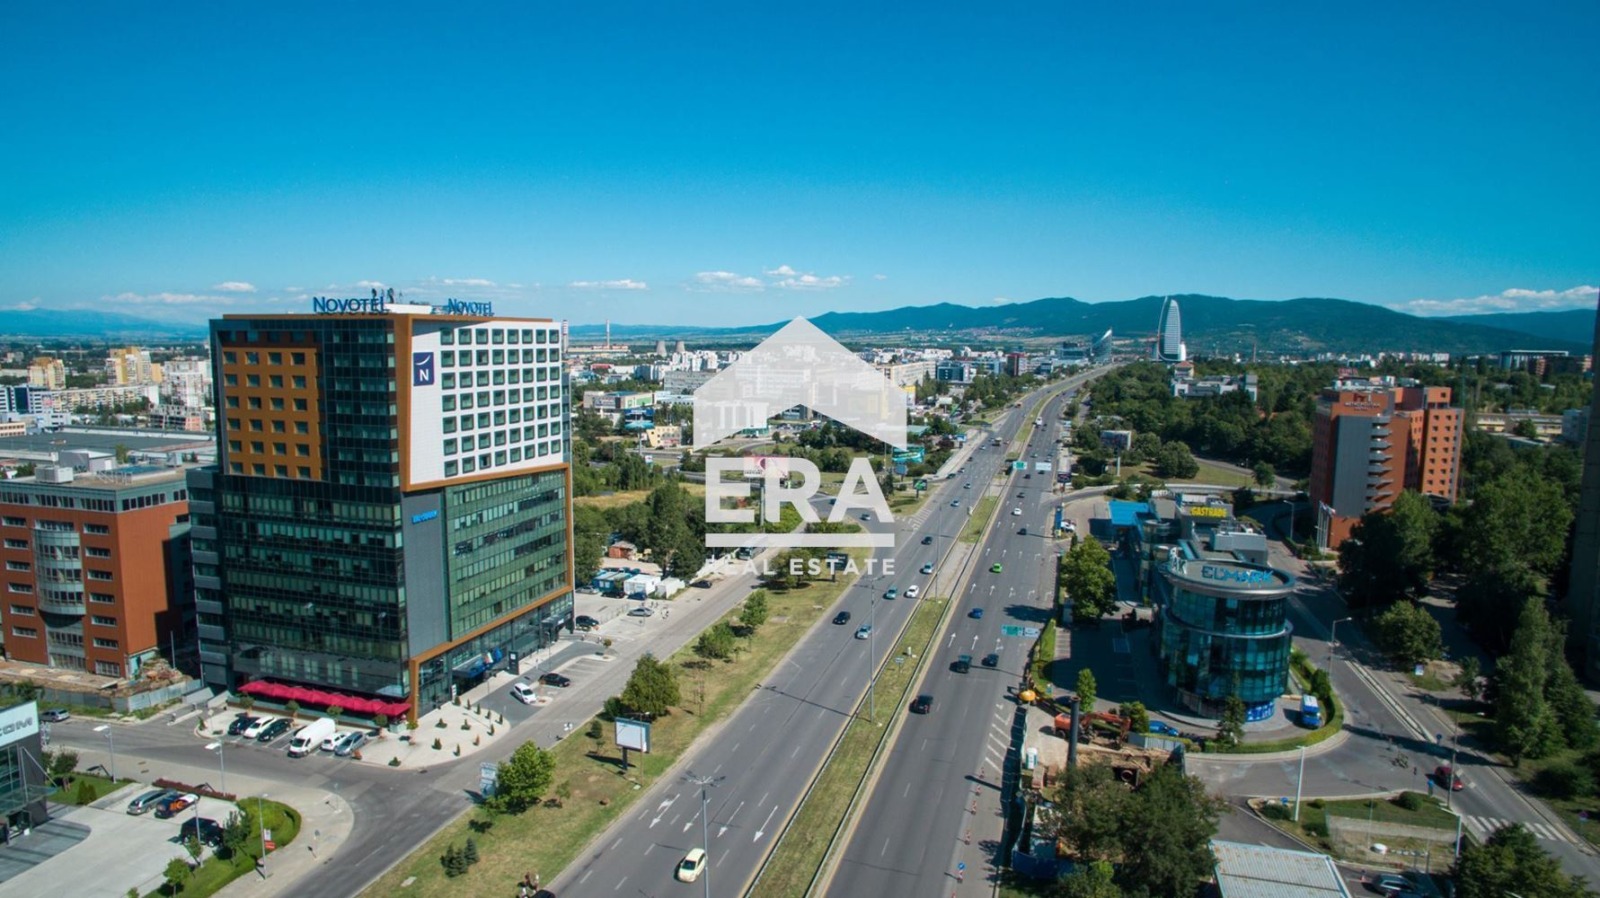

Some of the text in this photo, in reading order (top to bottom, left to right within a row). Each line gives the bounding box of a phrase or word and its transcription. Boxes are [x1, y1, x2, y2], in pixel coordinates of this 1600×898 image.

[313, 296, 390, 312] NOVOTEL
[448, 298, 495, 316] NOVOTEL
[420, 369, 429, 381] N
[0, 716, 33, 737] OM
